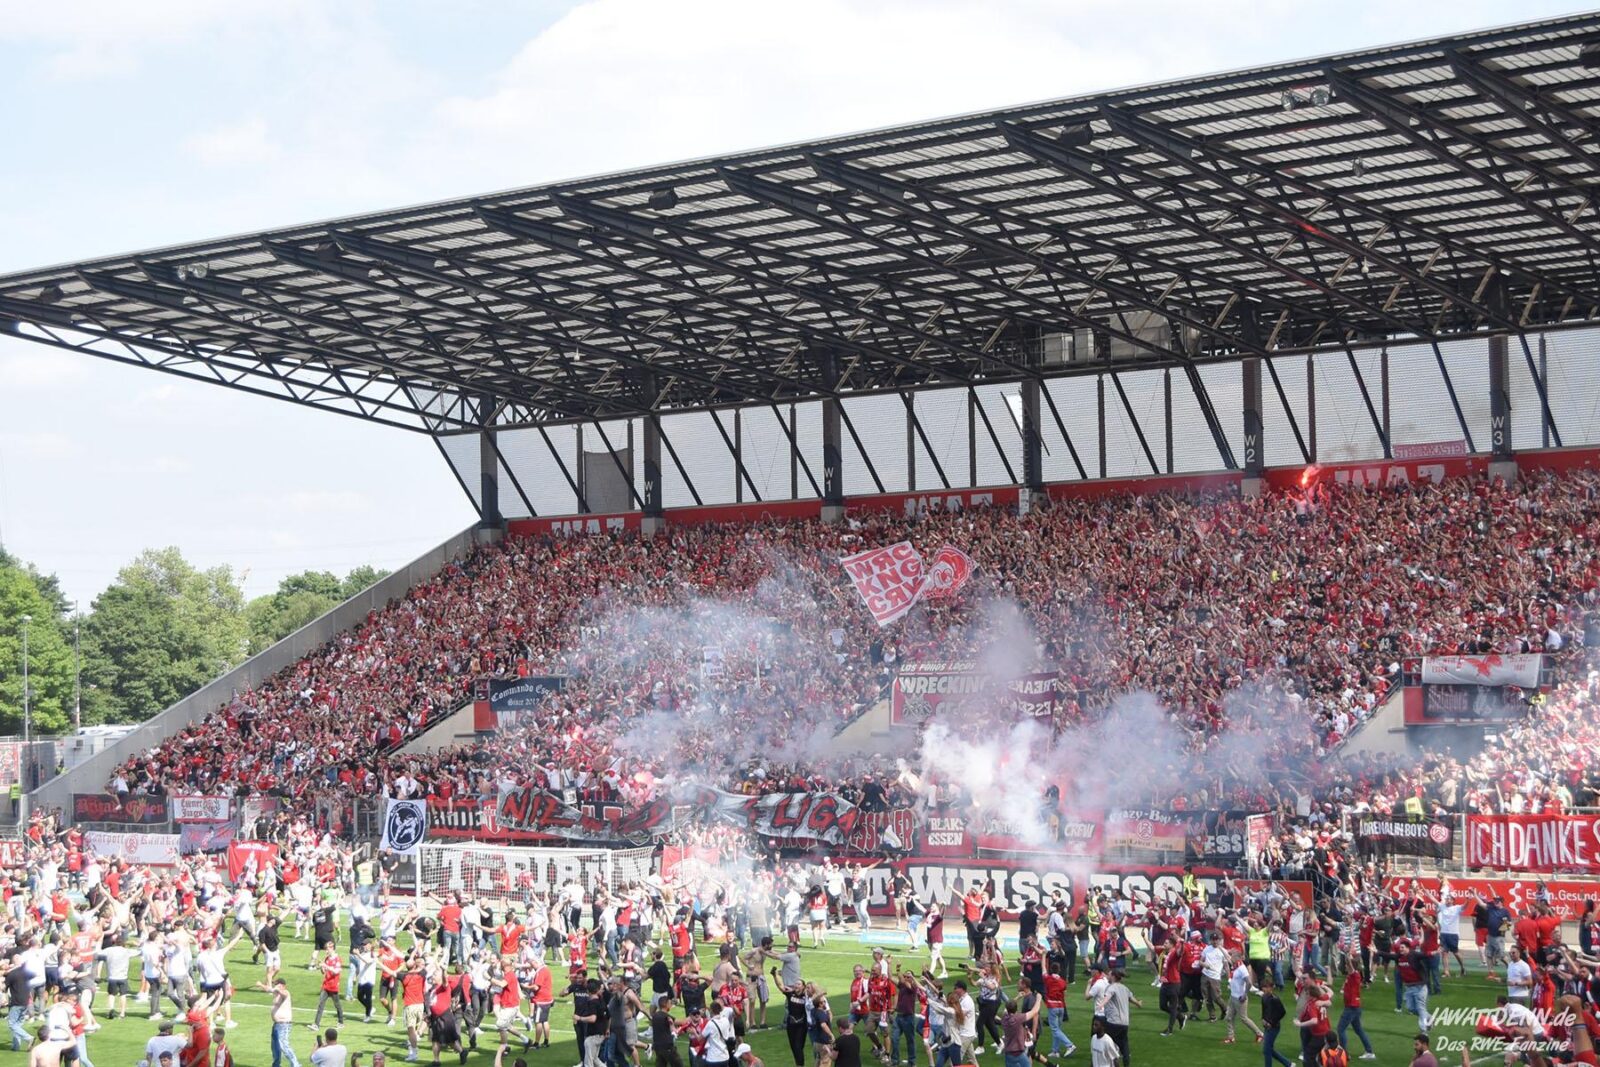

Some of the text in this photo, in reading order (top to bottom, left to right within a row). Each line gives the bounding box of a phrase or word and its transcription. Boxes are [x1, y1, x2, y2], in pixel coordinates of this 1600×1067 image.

[1490, 416, 1504, 429] W
[1244, 434, 1256, 447] W
[1493, 430, 1504, 446] 3
[1246, 448, 1256, 463] 2
[824, 467, 834, 479] W
[645, 481, 654, 491] W
[826, 479, 832, 492] 1
[646, 492, 651, 505] 1
[899, 676, 991, 694] WRECKIN
[770, 794, 859, 840] LIGA
[1064, 822, 1096, 840] CREW
[928, 832, 963, 846] ESSEN
[907, 866, 1072, 914] WEISS
